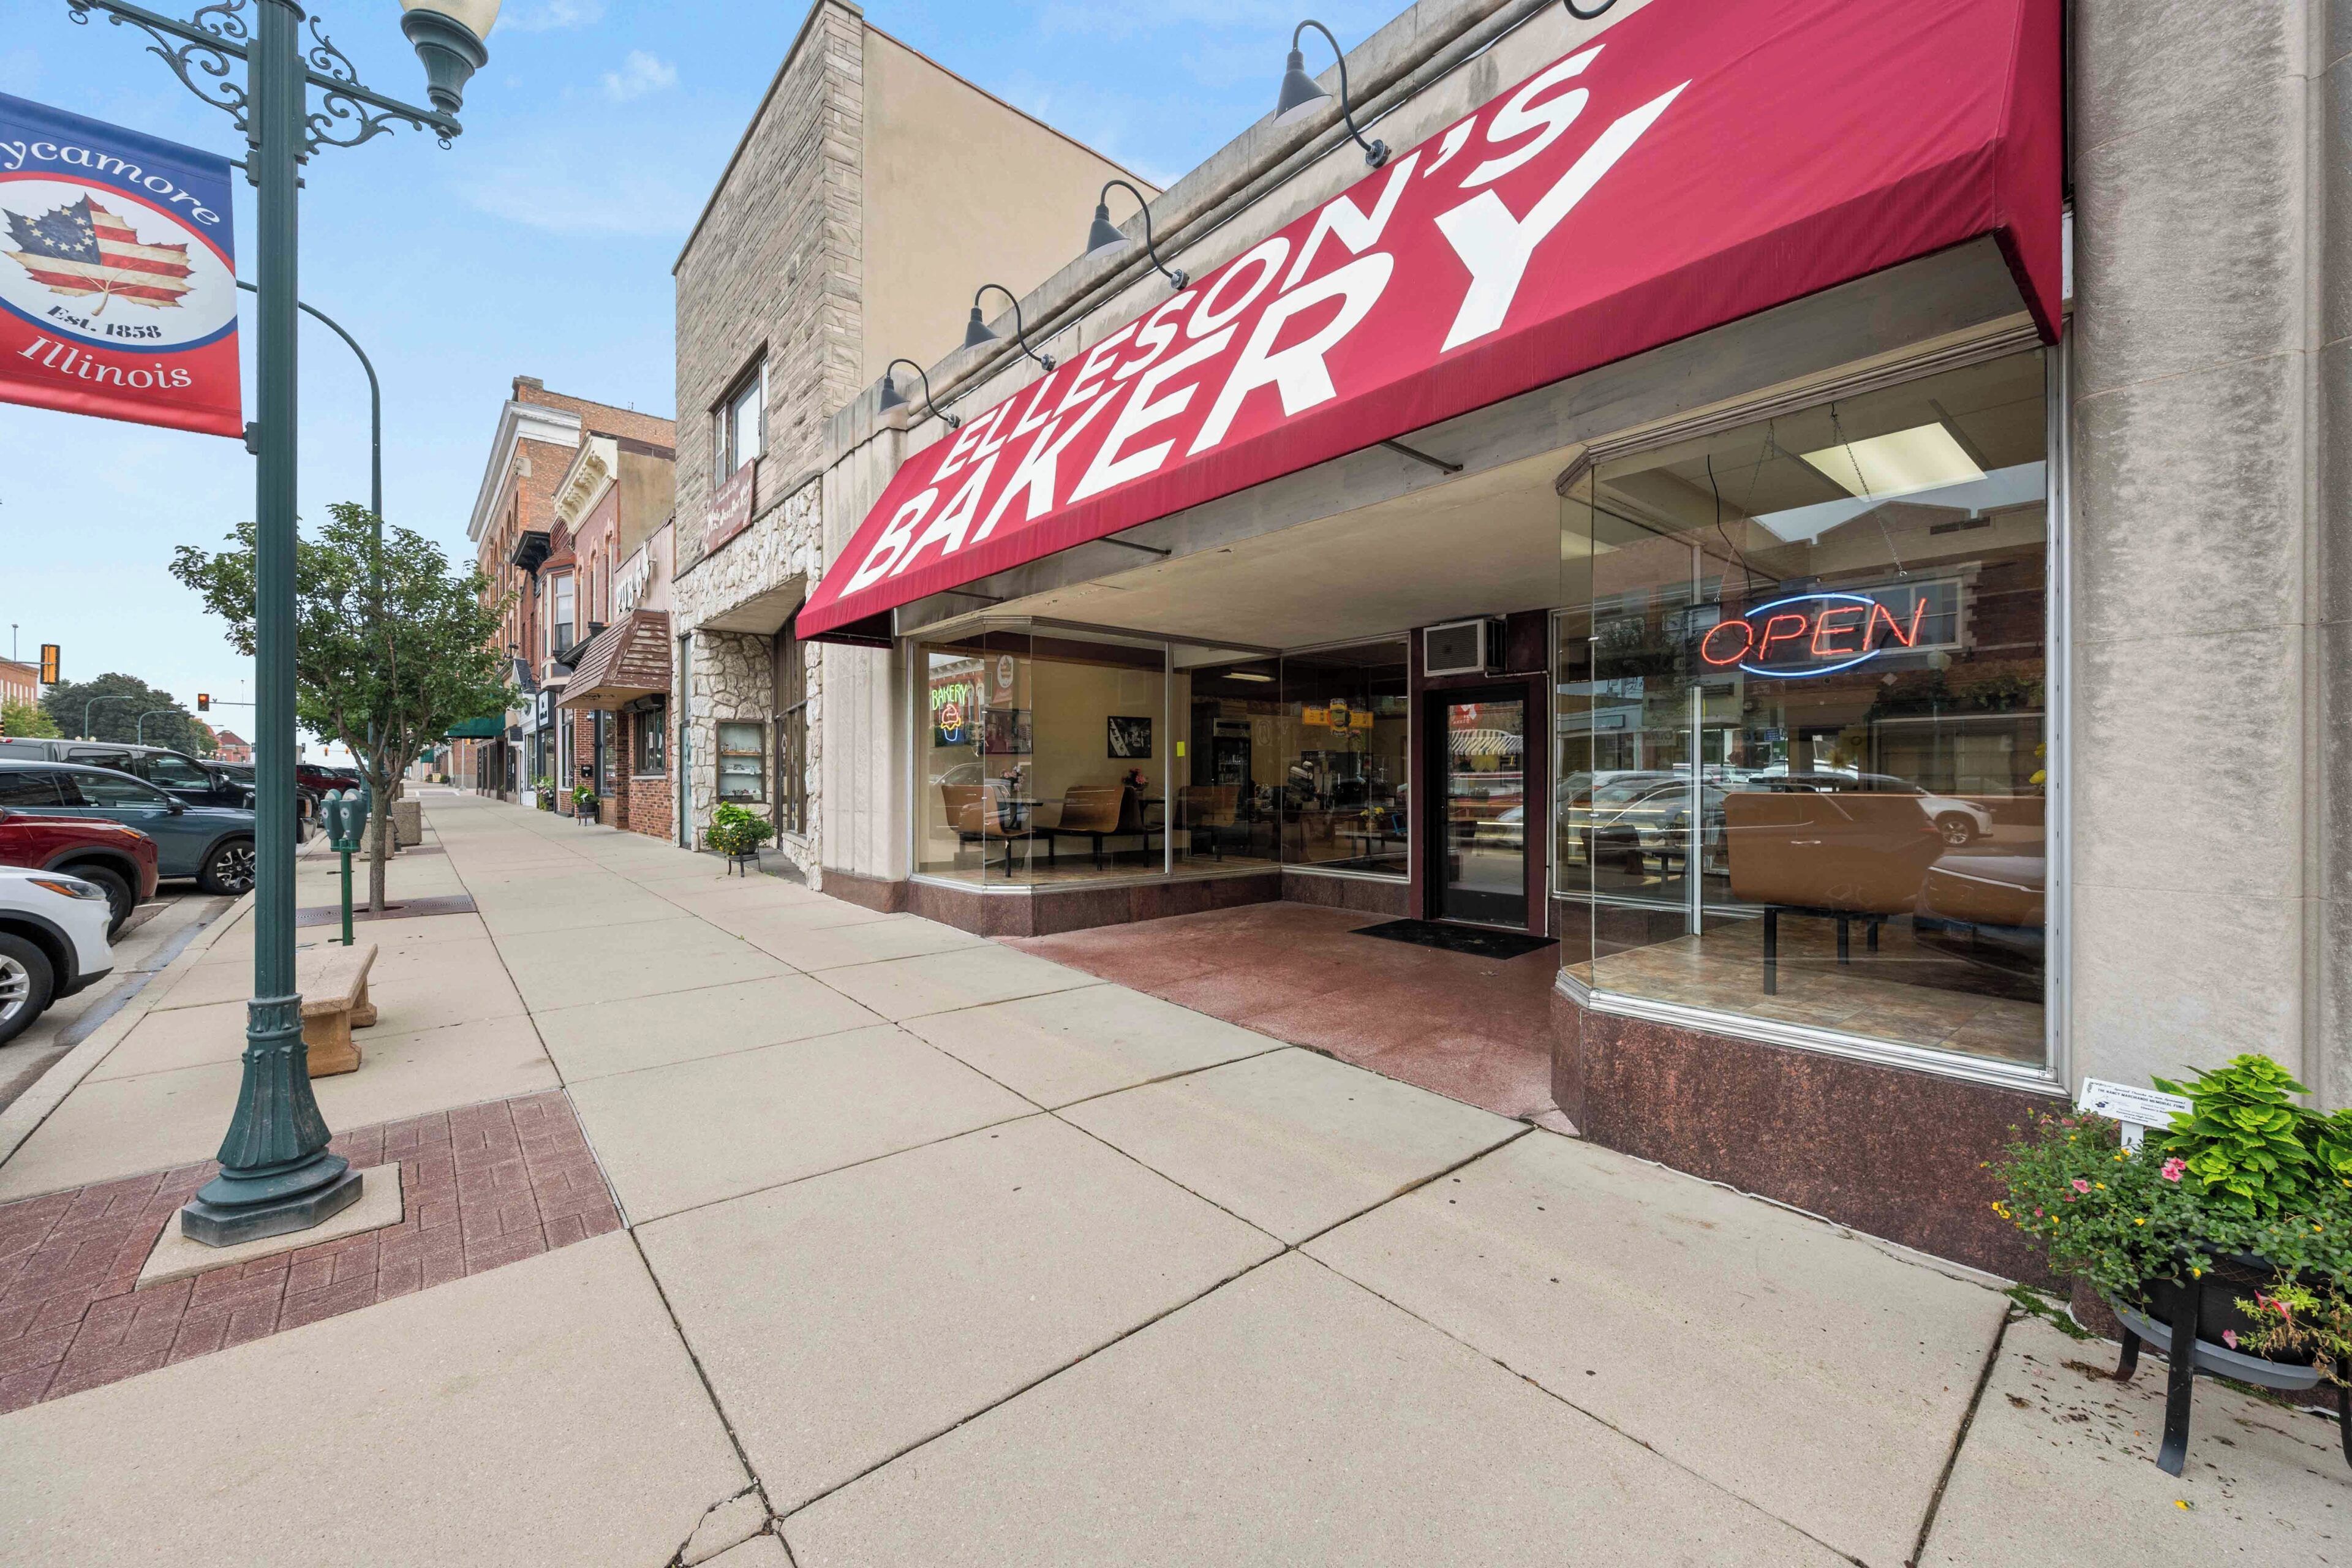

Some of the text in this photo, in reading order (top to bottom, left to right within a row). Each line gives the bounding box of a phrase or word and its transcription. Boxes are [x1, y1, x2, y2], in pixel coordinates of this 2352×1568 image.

[0, 141, 221, 226] ycamore
[929, 44, 1605, 484] ELLESON'S
[46, 305, 162, 339] Est. 1858
[839, 79, 1692, 598] BAKERY
[17, 336, 192, 389] Illinois
[1701, 597, 1927, 665] OPEN
[932, 684, 968, 710] BAKERY
